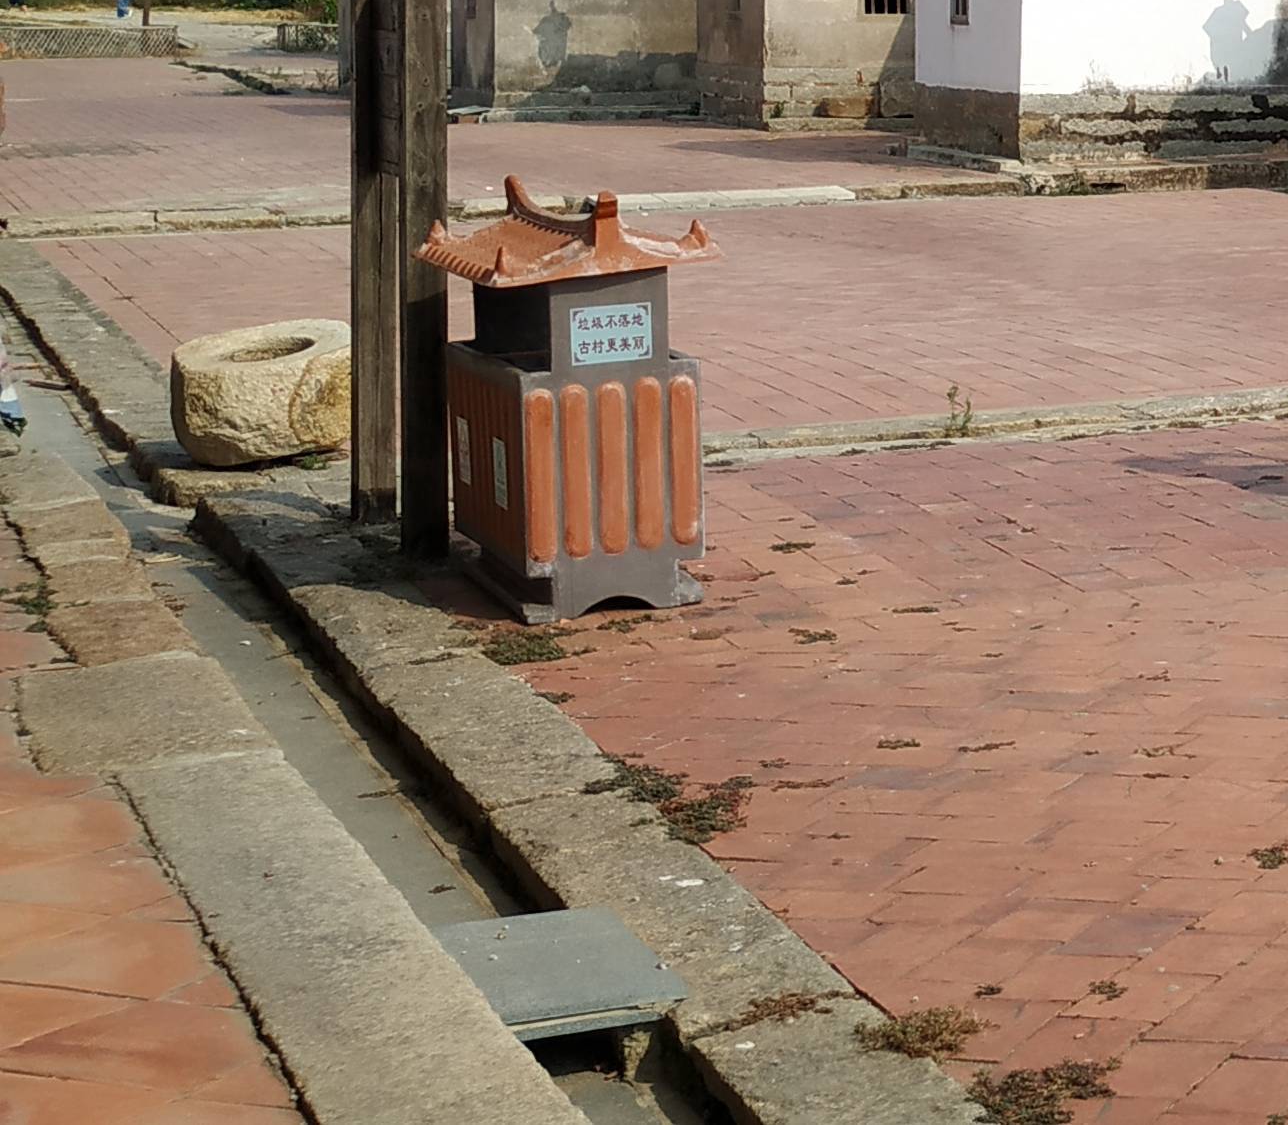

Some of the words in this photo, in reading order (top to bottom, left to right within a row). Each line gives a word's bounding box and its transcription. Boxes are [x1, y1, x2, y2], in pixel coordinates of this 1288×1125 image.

[577, 312, 645, 331] 垃圾不落地
[577, 335, 646, 355] 古村更美丽
